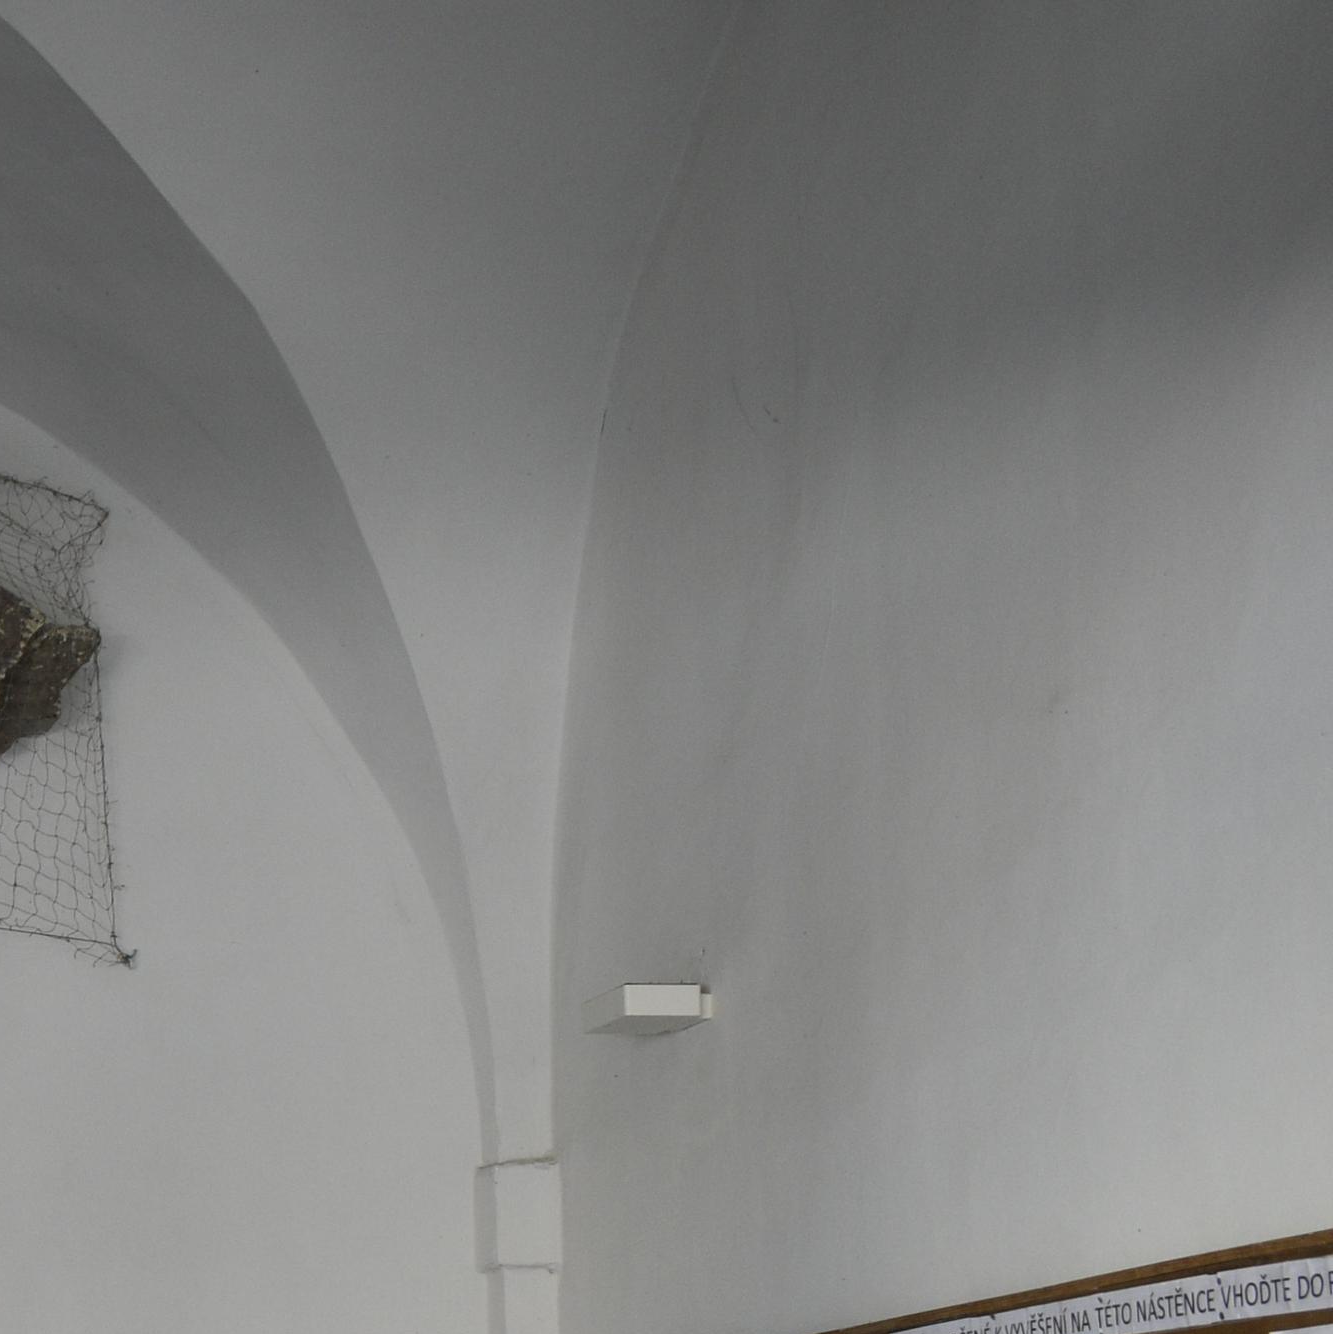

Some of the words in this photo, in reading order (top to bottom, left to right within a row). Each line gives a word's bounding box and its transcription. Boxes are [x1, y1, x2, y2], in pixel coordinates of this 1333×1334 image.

[1071, 1309, 1091, 1334] NA
[1095, 1299, 1132, 1328] TÉTO
[1136, 1286, 1216, 1322] NÁSTĚNCE
[1221, 1274, 1291, 1309] VHOĎTE
[1298, 1273, 1324, 1300] DO
